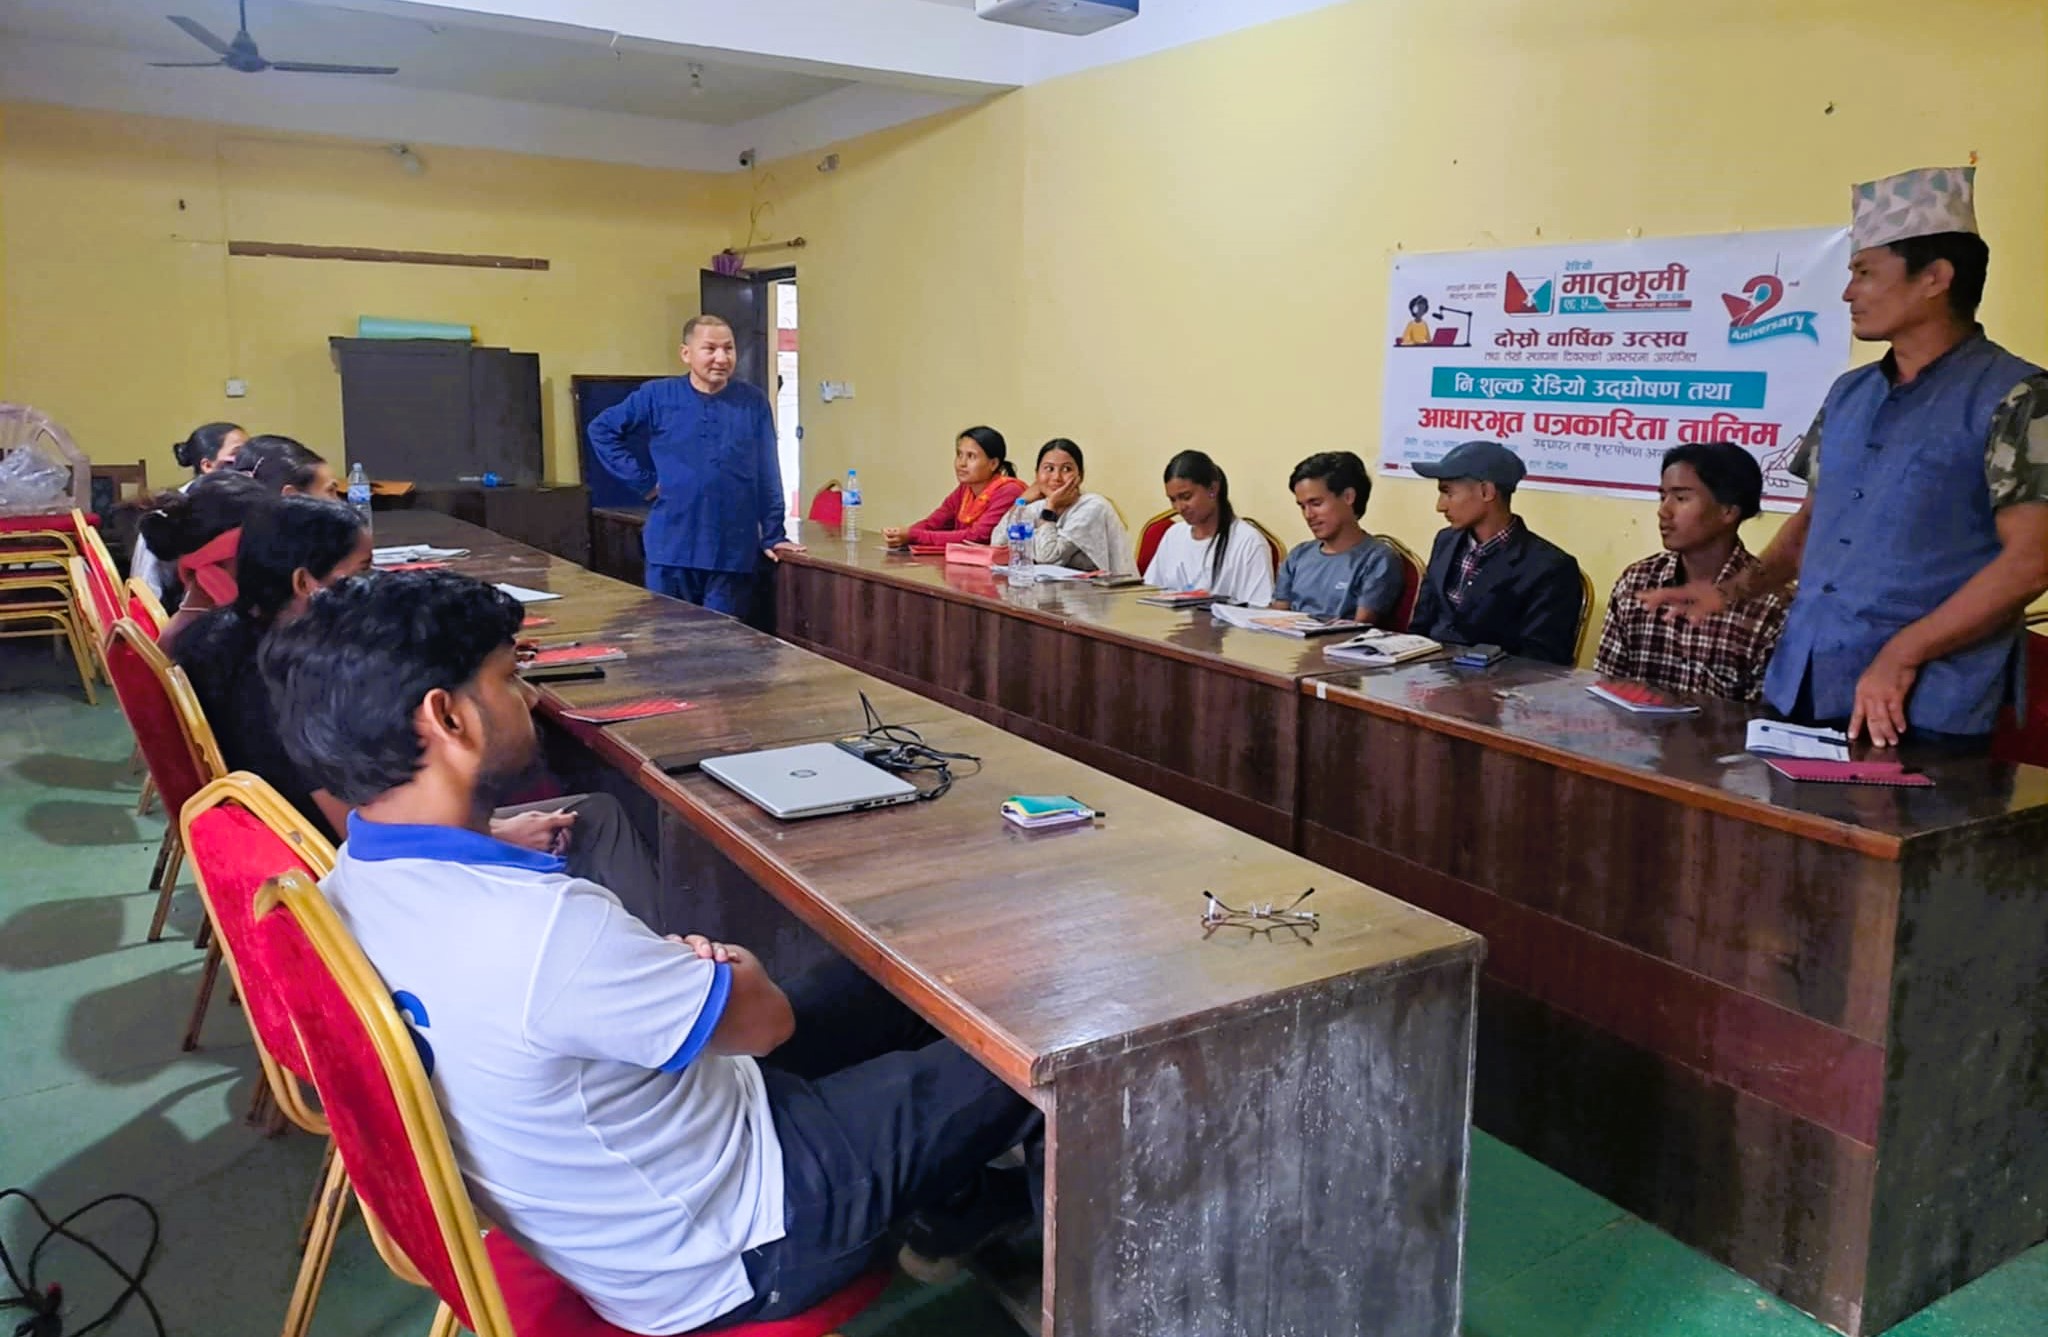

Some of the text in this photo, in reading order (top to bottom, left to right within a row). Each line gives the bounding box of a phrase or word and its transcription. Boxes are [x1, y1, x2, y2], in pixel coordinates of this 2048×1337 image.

[1562, 262, 1690, 299] मातृभूमी
[1494, 326, 1689, 349] दोस्रो वार्षिक उत्सव
[1731, 314, 1806, 341] Aniversary
[1479, 377, 1525, 398] शुल्क
[1530, 374, 1586, 396] रेडियो
[1687, 382, 1733, 401] तथा
[1418, 407, 1782, 447] आधारभूत पत्रकारिता तालिम
